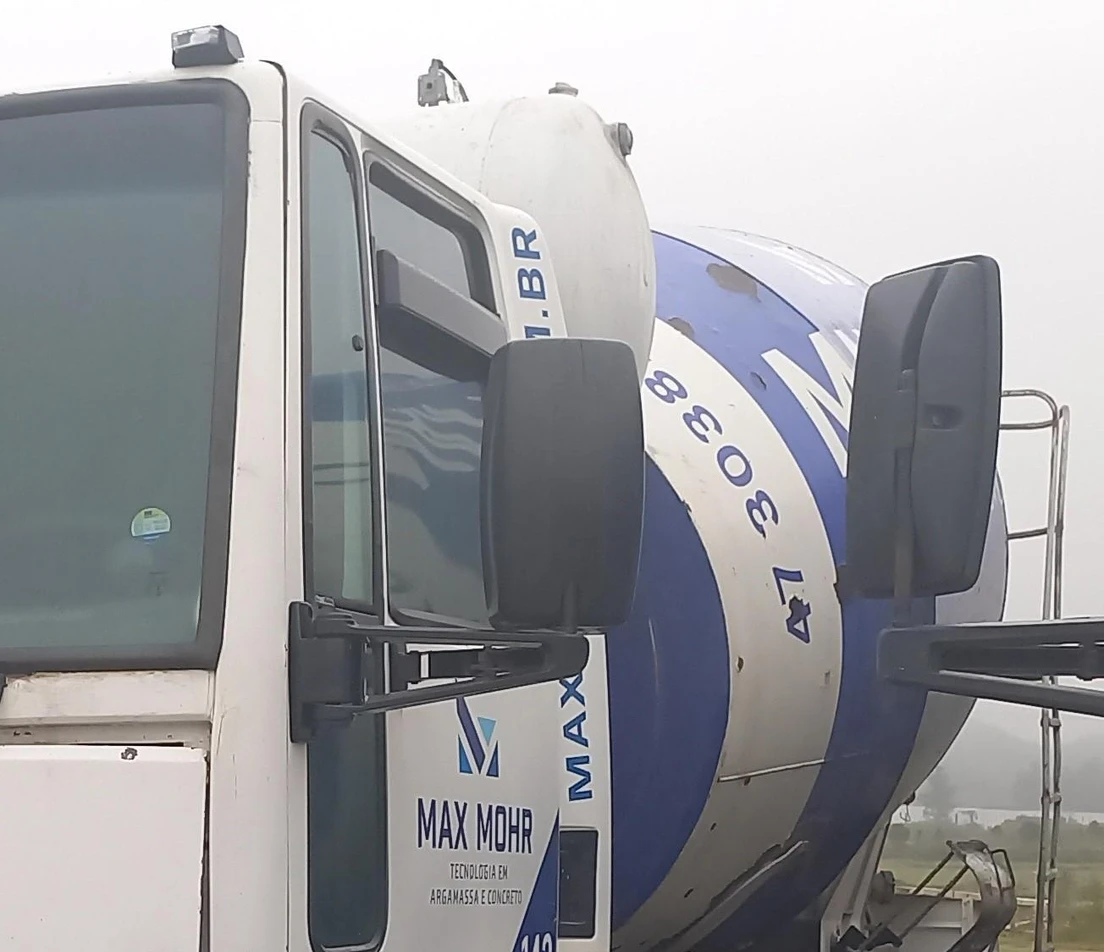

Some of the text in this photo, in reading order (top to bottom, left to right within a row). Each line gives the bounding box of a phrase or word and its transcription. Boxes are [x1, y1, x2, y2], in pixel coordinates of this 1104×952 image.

[645, 370, 778, 539] 3038
[559, 670, 594, 802] MAX
[417, 797, 533, 854] MAX MOHR
[429, 888, 523, 905] ARGAMASSA E CONCRETO
[449, 863, 508, 880] TECNOLOGIA EM
